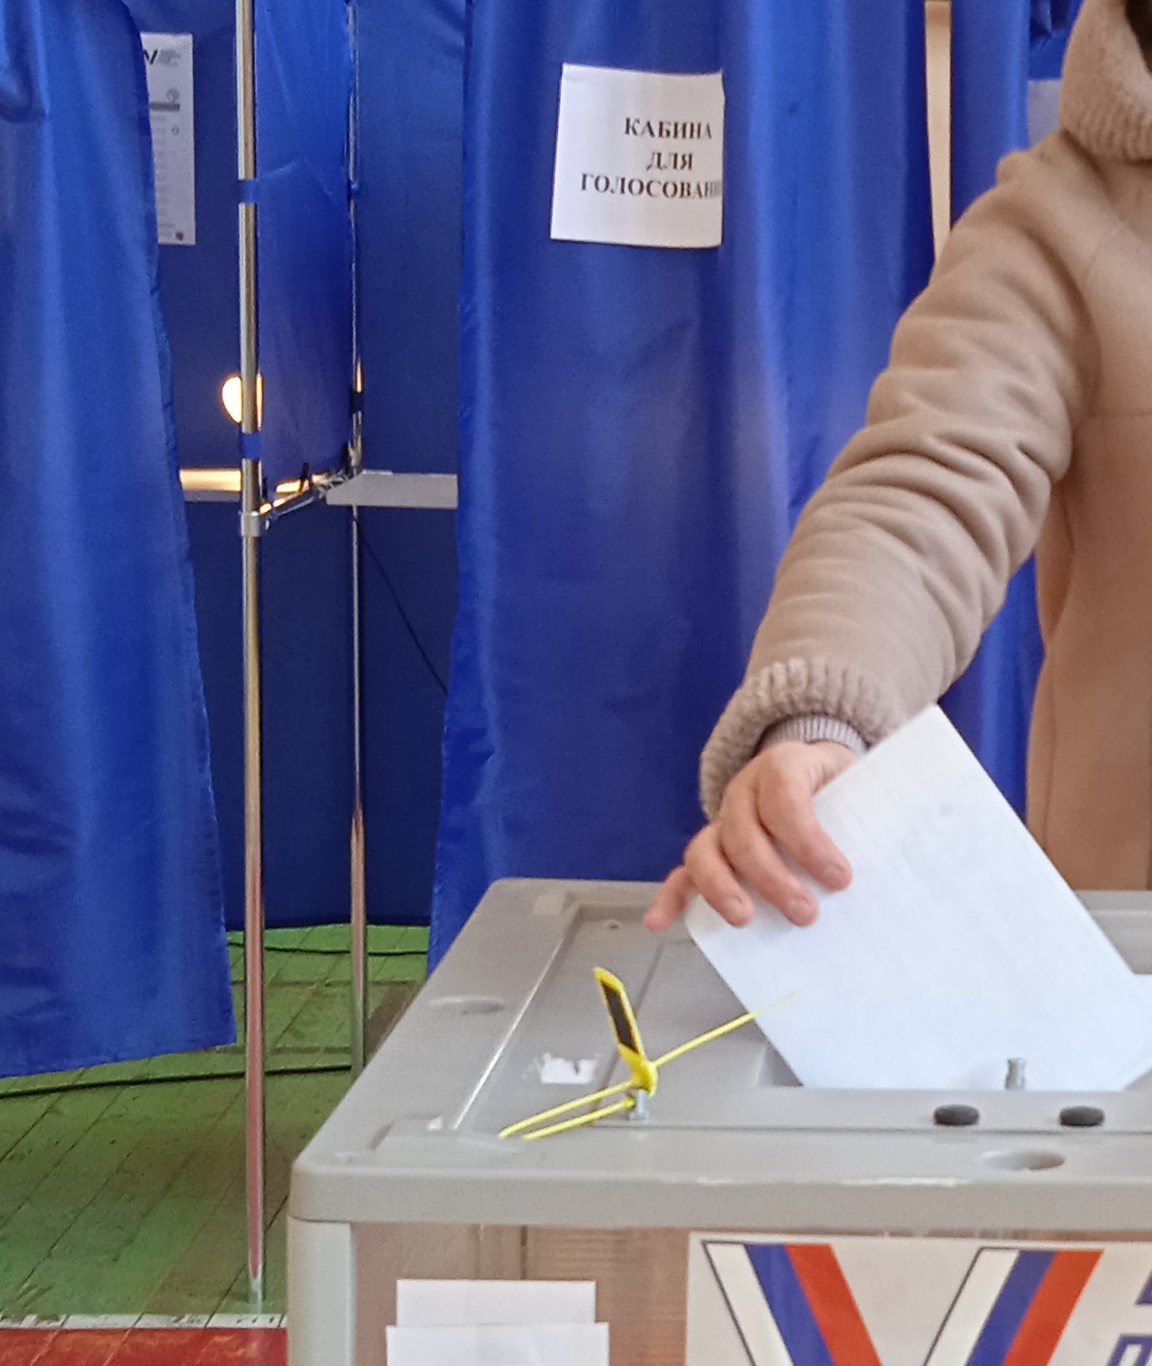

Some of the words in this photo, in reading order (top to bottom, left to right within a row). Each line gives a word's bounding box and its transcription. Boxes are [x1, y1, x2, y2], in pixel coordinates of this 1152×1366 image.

[624, 116, 713, 140] КАБИНА
[646, 150, 694, 172] ДЛЯ
[580, 172, 722, 199] ГОЛОСОВАН
